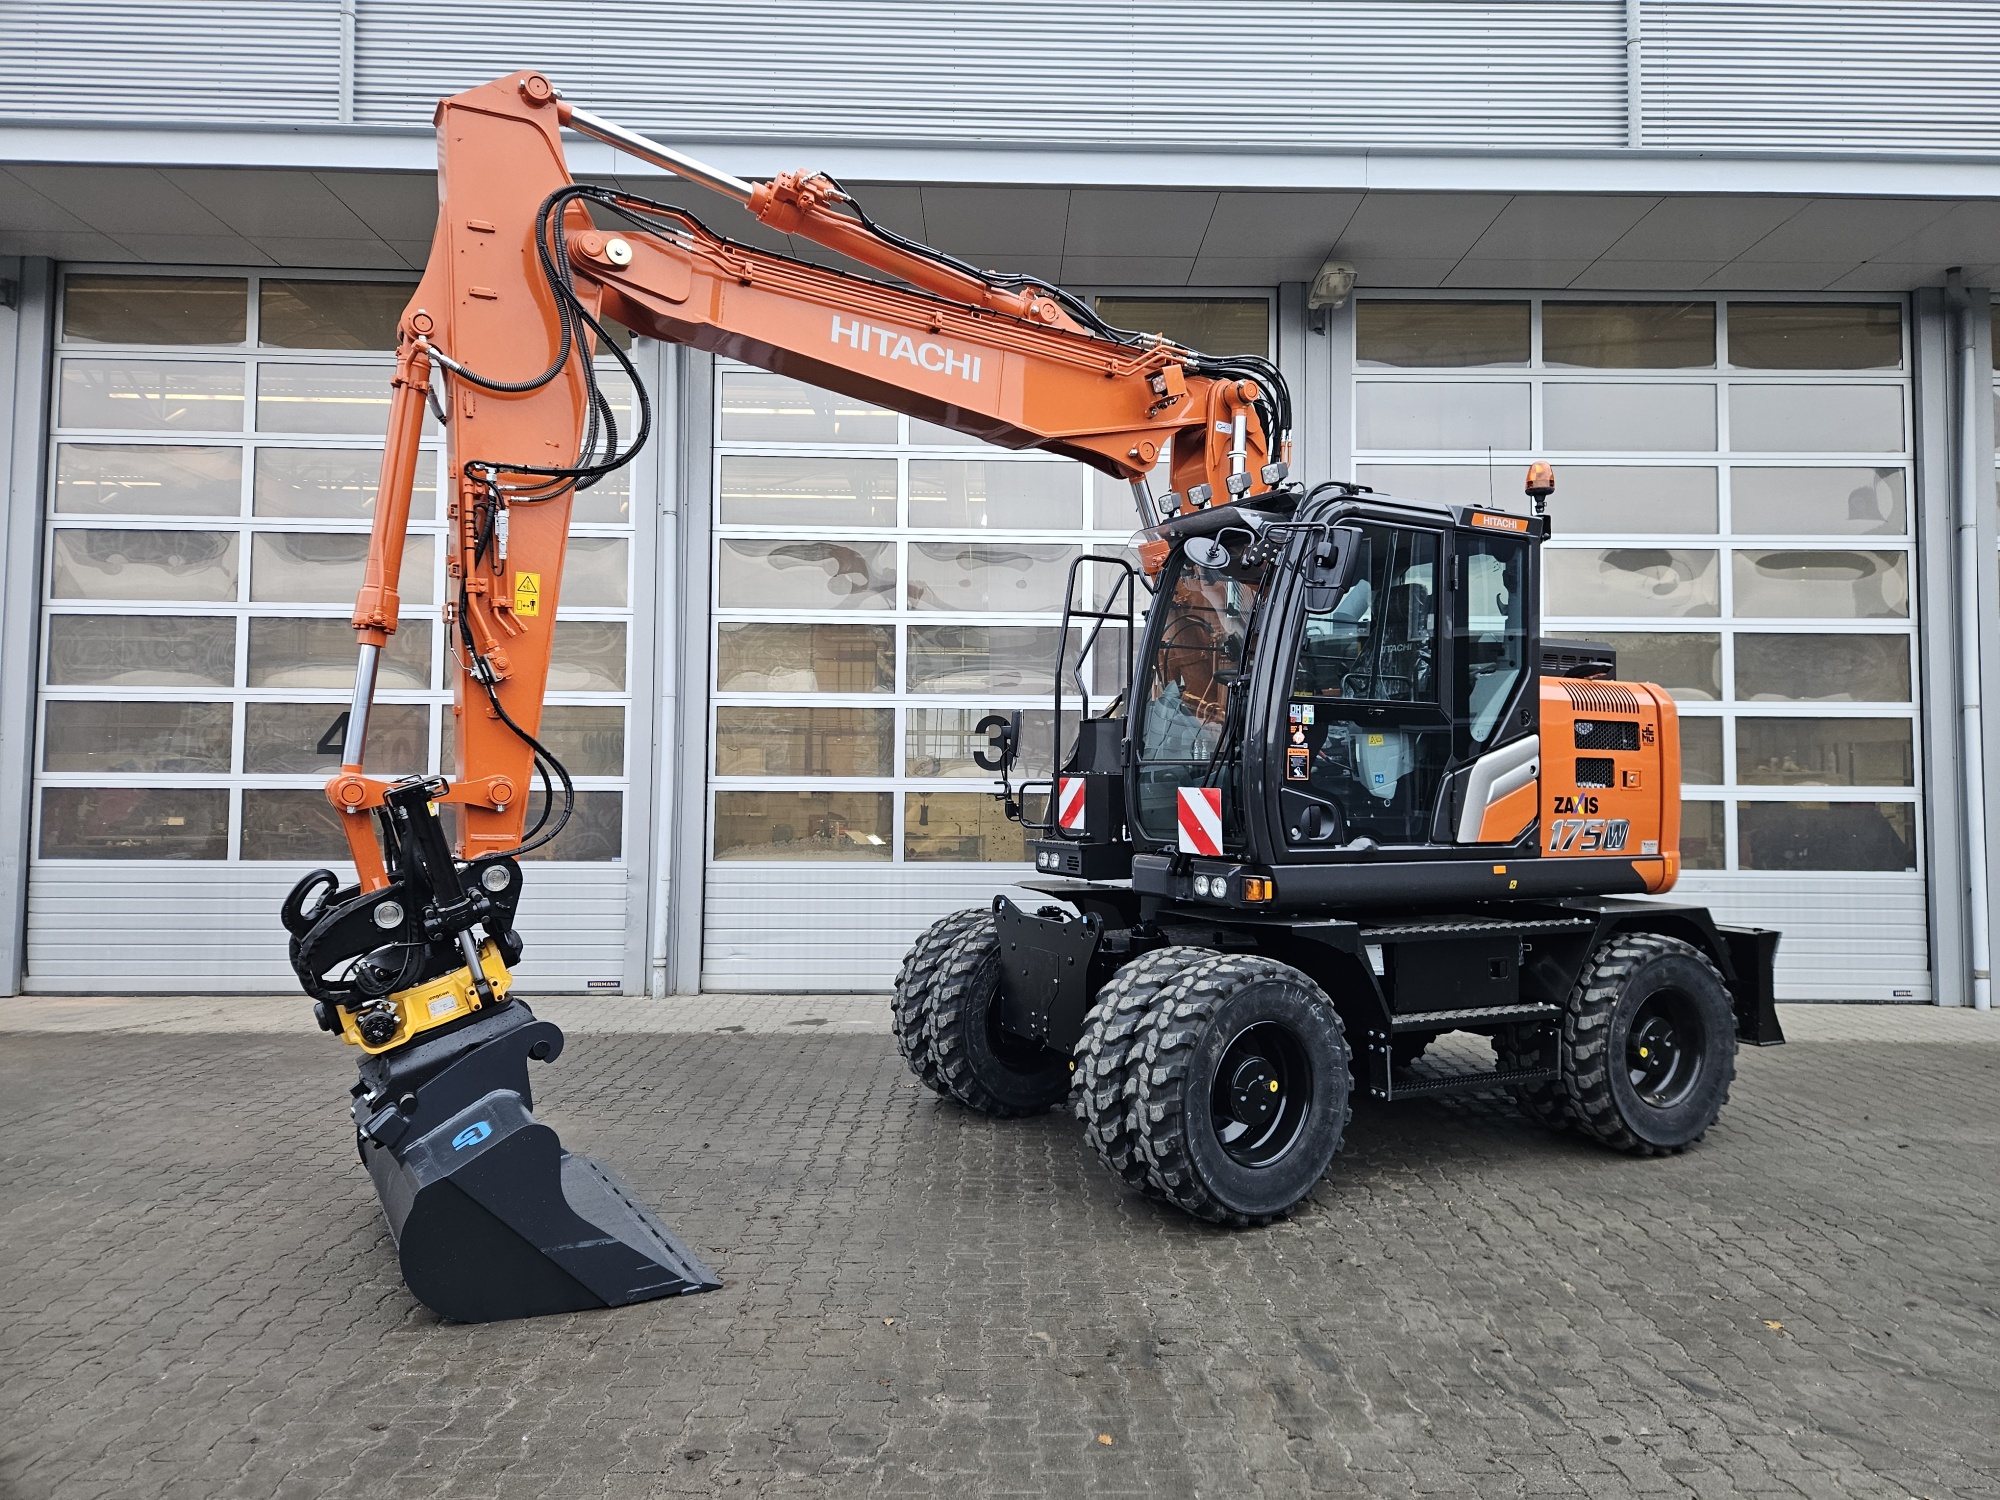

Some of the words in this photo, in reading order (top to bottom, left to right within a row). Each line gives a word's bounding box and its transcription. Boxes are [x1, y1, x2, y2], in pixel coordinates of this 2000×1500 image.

[830, 315, 981, 384] HITACHI
[1483, 515, 1517, 529] HITACHI
[317, 711, 350, 767] 4
[973, 715, 1013, 771] 3
[1554, 792, 1599, 815] ZAXIS
[1548, 818, 1631, 852] 175W
